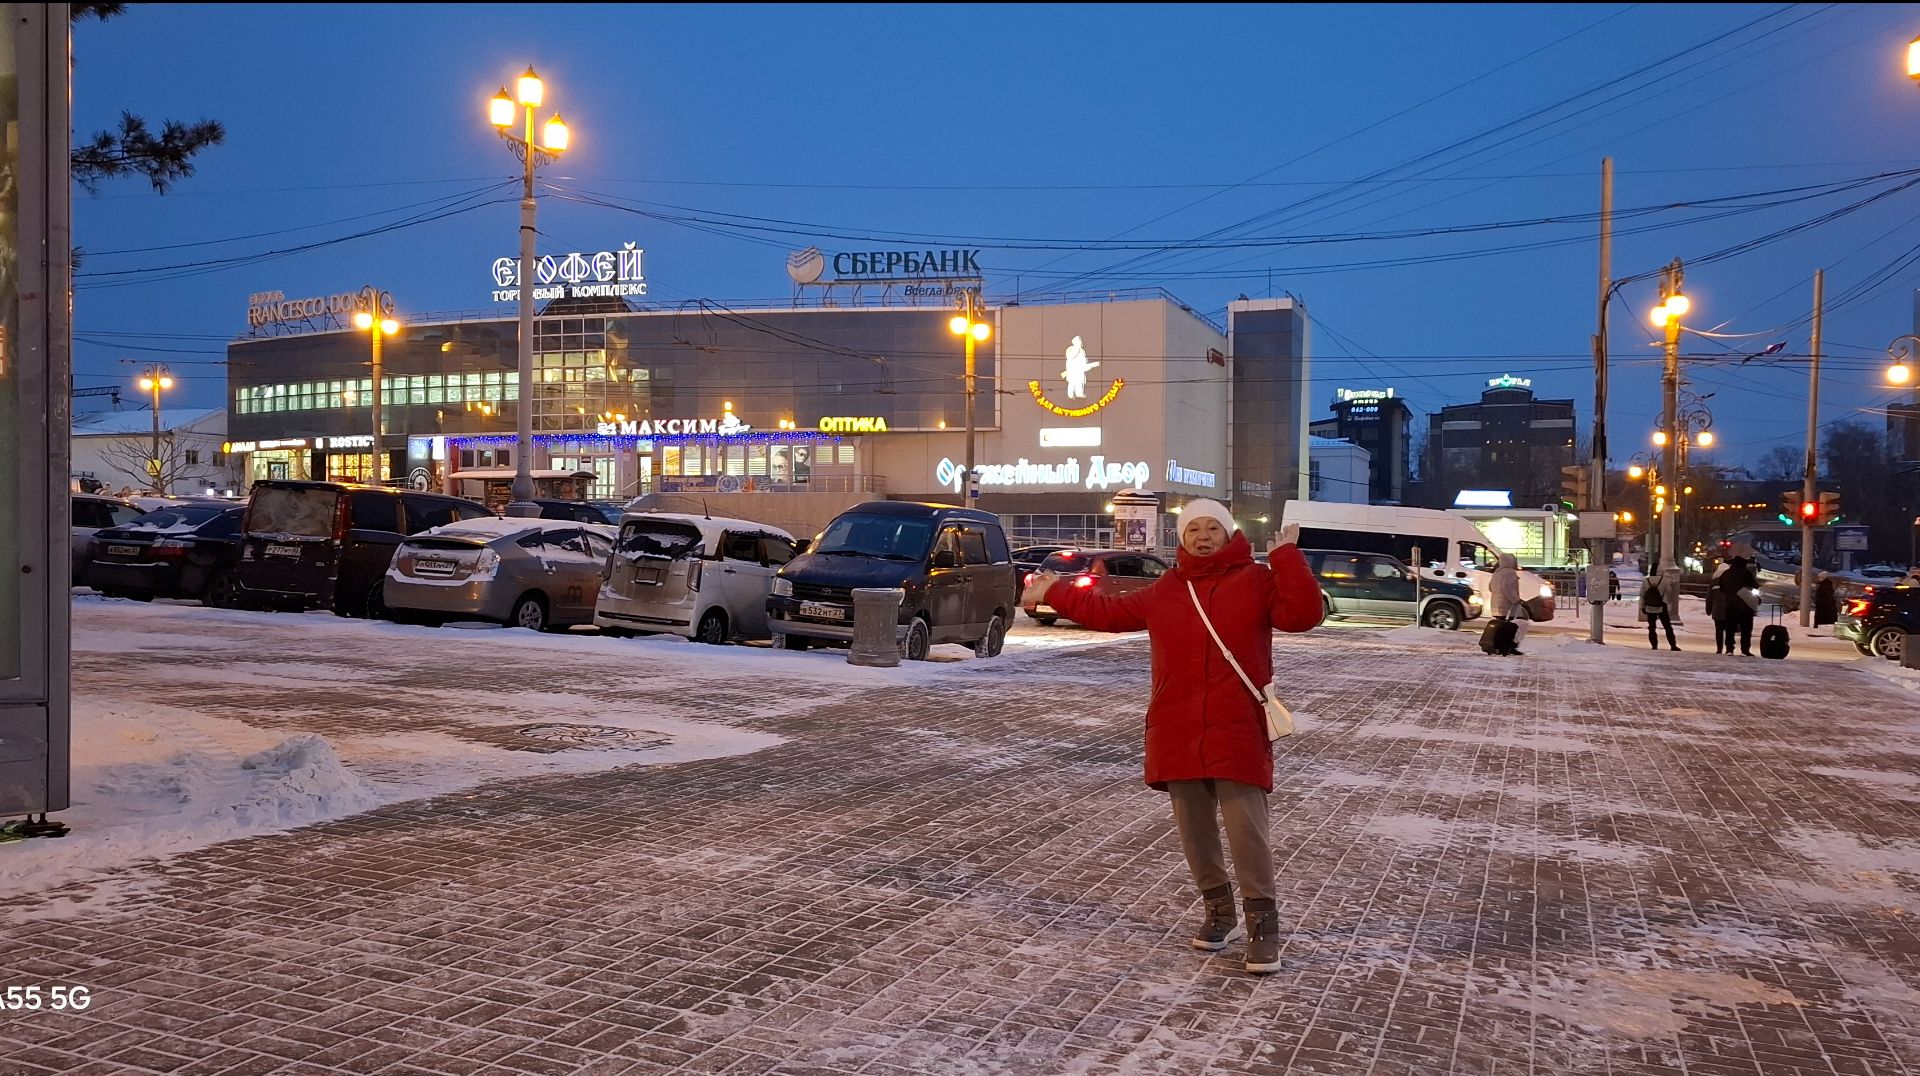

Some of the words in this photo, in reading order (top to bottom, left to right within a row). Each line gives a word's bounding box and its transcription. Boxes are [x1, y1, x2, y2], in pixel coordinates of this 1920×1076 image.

[834, 250, 982, 275] СБЕРБАНК
[492, 285, 565, 302] ТОРВЫЙ
[572, 283, 647, 298] КОМПЛЕКС
[904, 285, 942, 297] Всегда
[247, 297, 325, 325] FRANCESCO
[620, 418, 717, 436] МАКСИМ
[819, 415, 887, 432] ОПТИКА
[329, 435, 375, 448] ROSTIC'
[936, 457, 1080, 494] Оржейный
[1085, 455, 1150, 490] Двор
